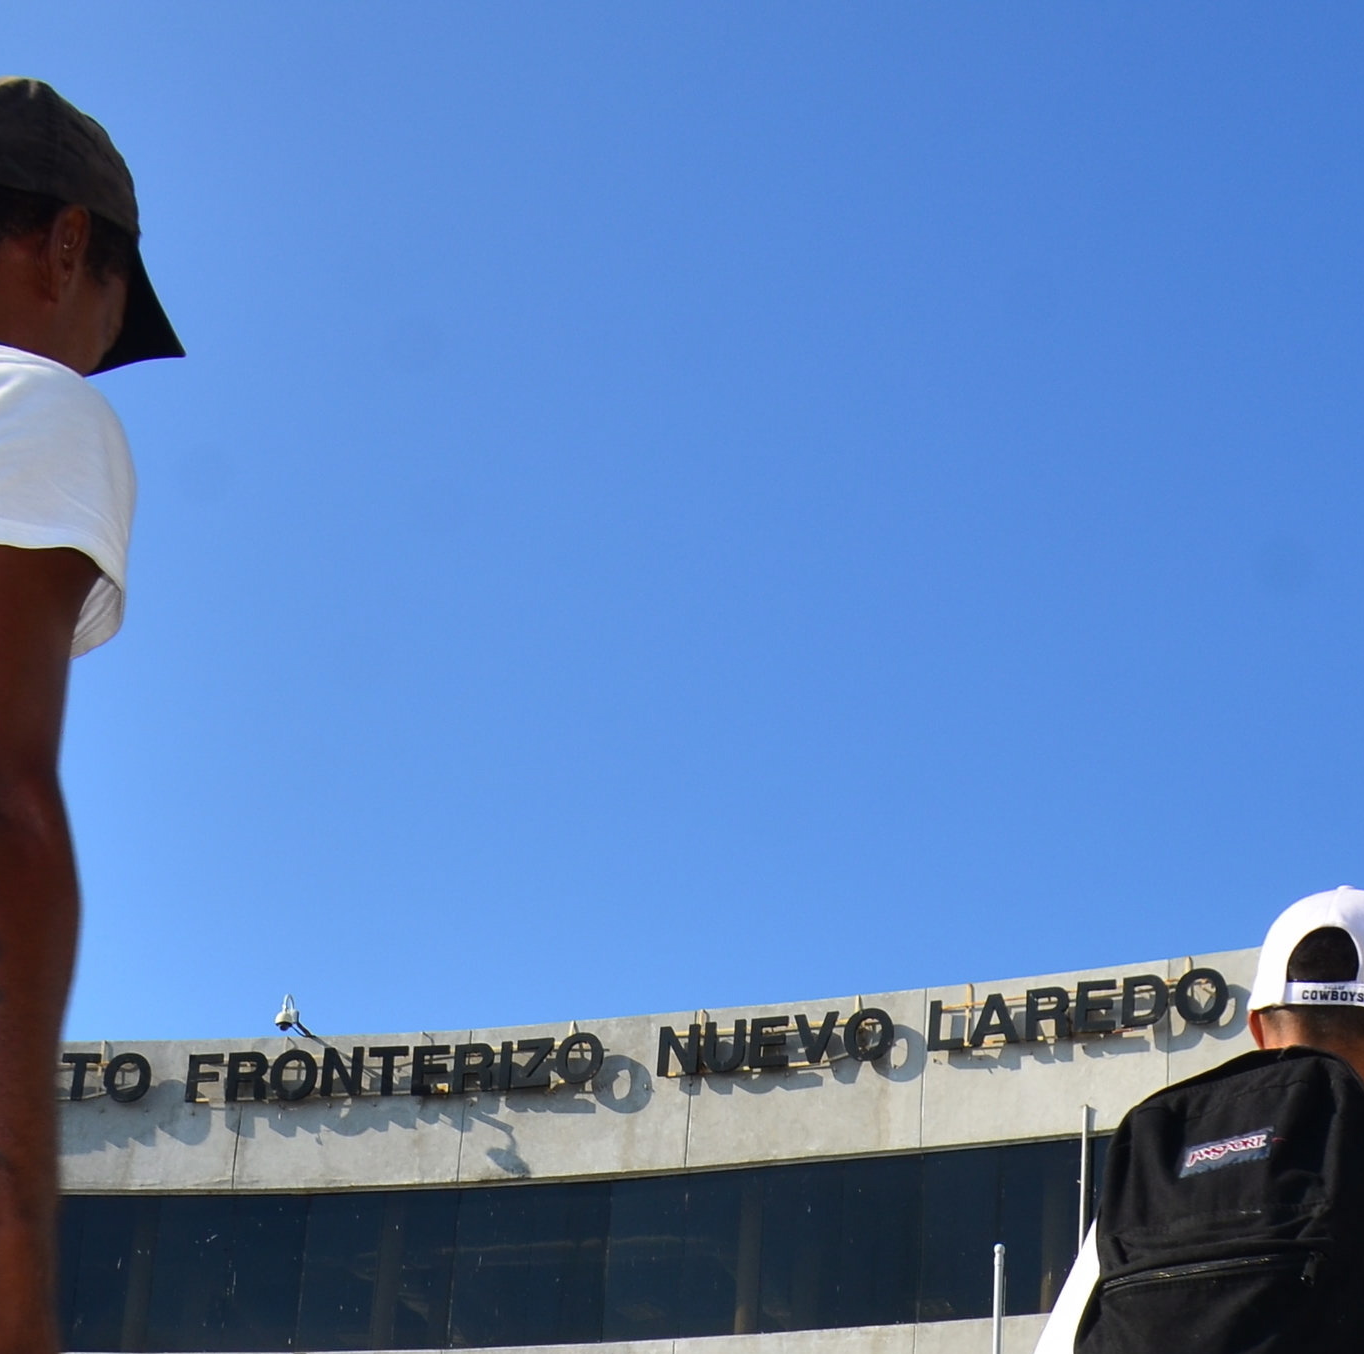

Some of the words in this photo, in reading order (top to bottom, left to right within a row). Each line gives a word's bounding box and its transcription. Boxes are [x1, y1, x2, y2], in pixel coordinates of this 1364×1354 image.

[1301, 989, 1364, 1003] COWBOYS
[185, 1031, 605, 1103] FRONTERIZO
[656, 1007, 896, 1077] NUEVO
[927, 967, 1229, 1052] LAREDO
